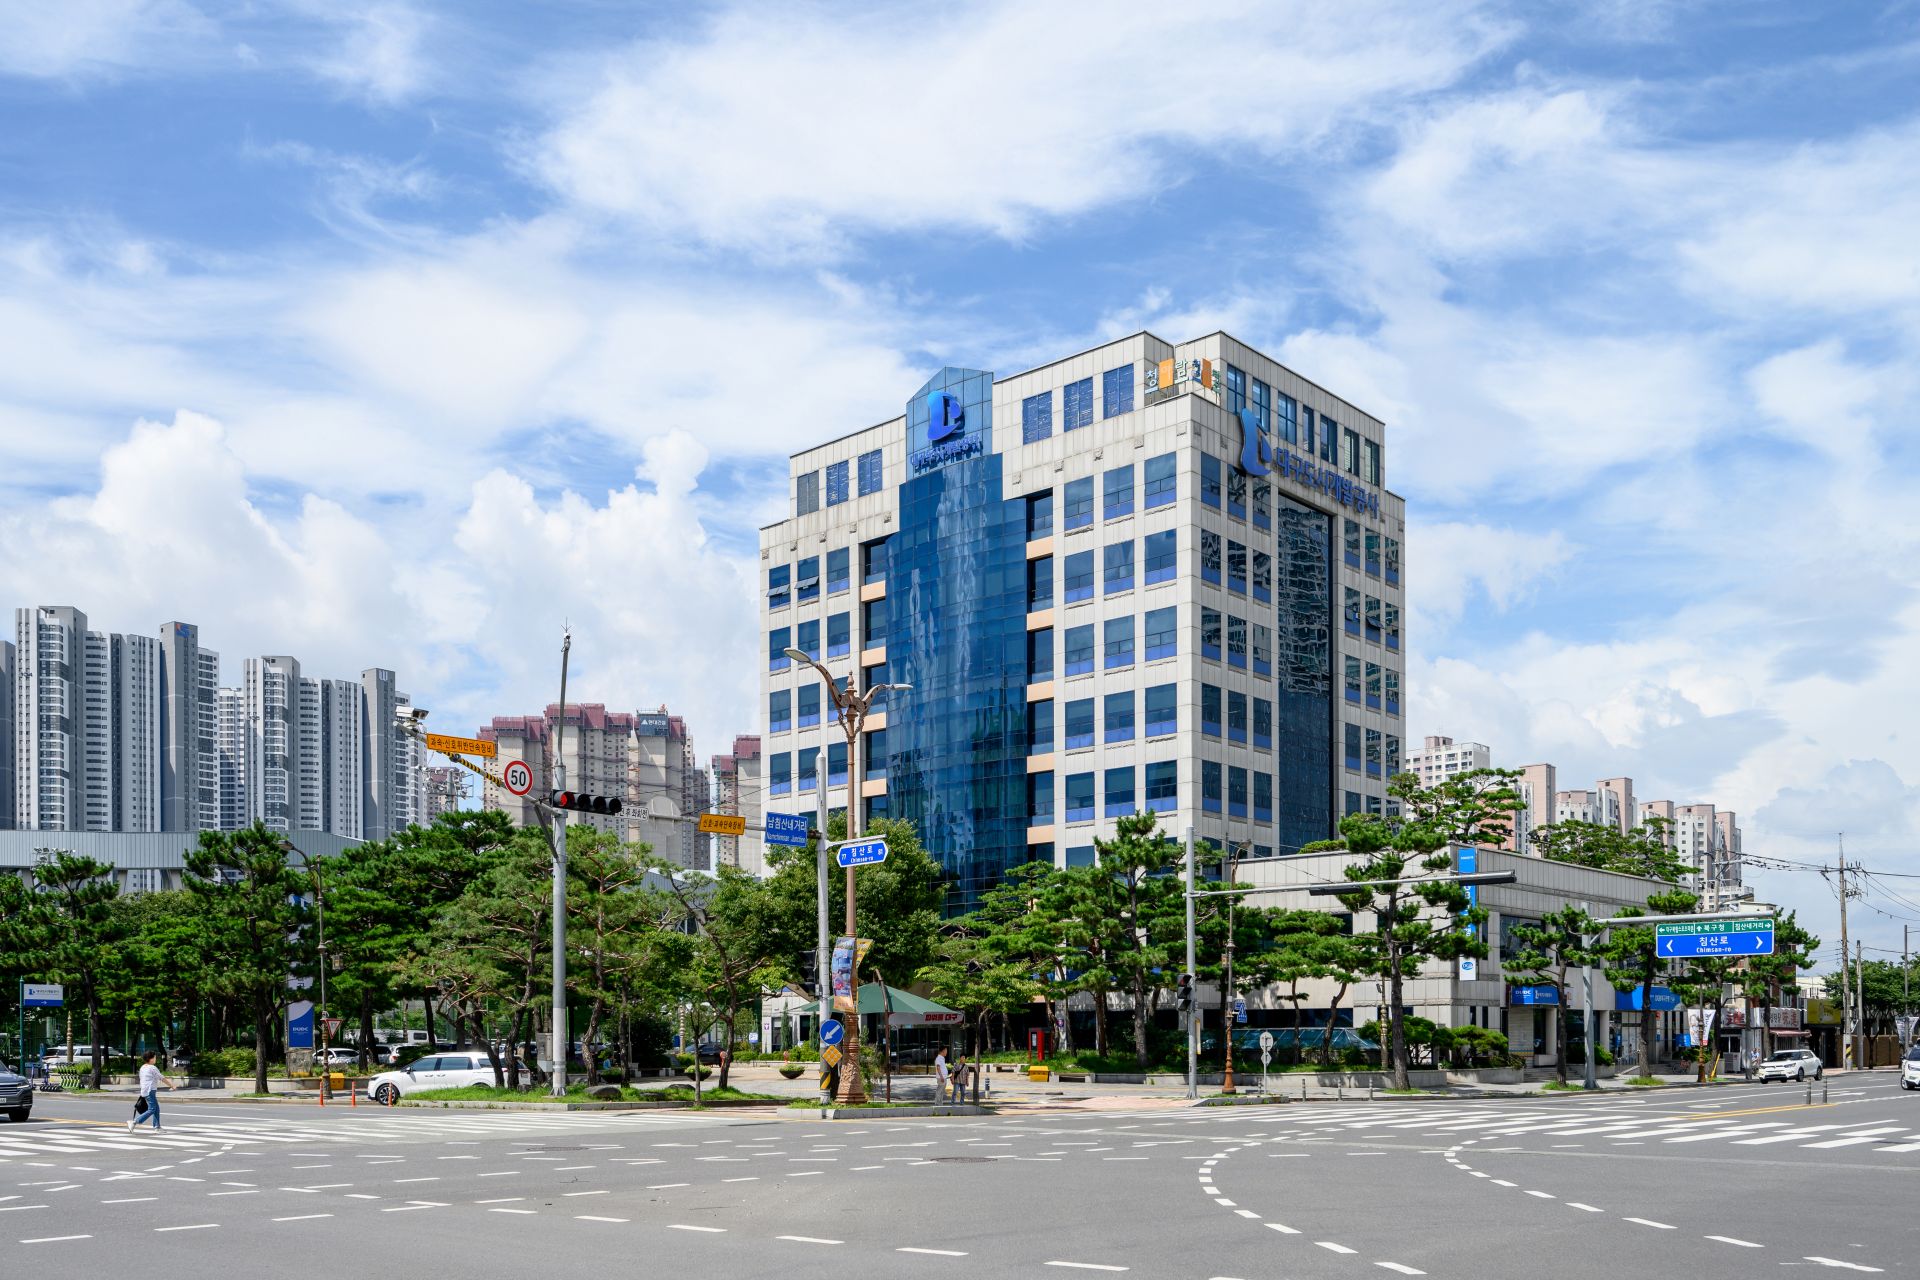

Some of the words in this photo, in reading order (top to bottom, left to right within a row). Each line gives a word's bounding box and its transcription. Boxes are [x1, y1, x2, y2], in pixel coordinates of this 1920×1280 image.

[1276, 447, 1379, 519] 대구도시개발공사
[511, 770, 526, 786] 50
[767, 817, 806, 831] 남침산네거리
[851, 845, 873, 857] 침산로
[1703, 923, 1725, 932] 북구청
[1734, 921, 1764, 931] 침산네거리
[1699, 936, 1729, 947] 침산로
[1696, 946, 1732, 954] Chimsan-ro
